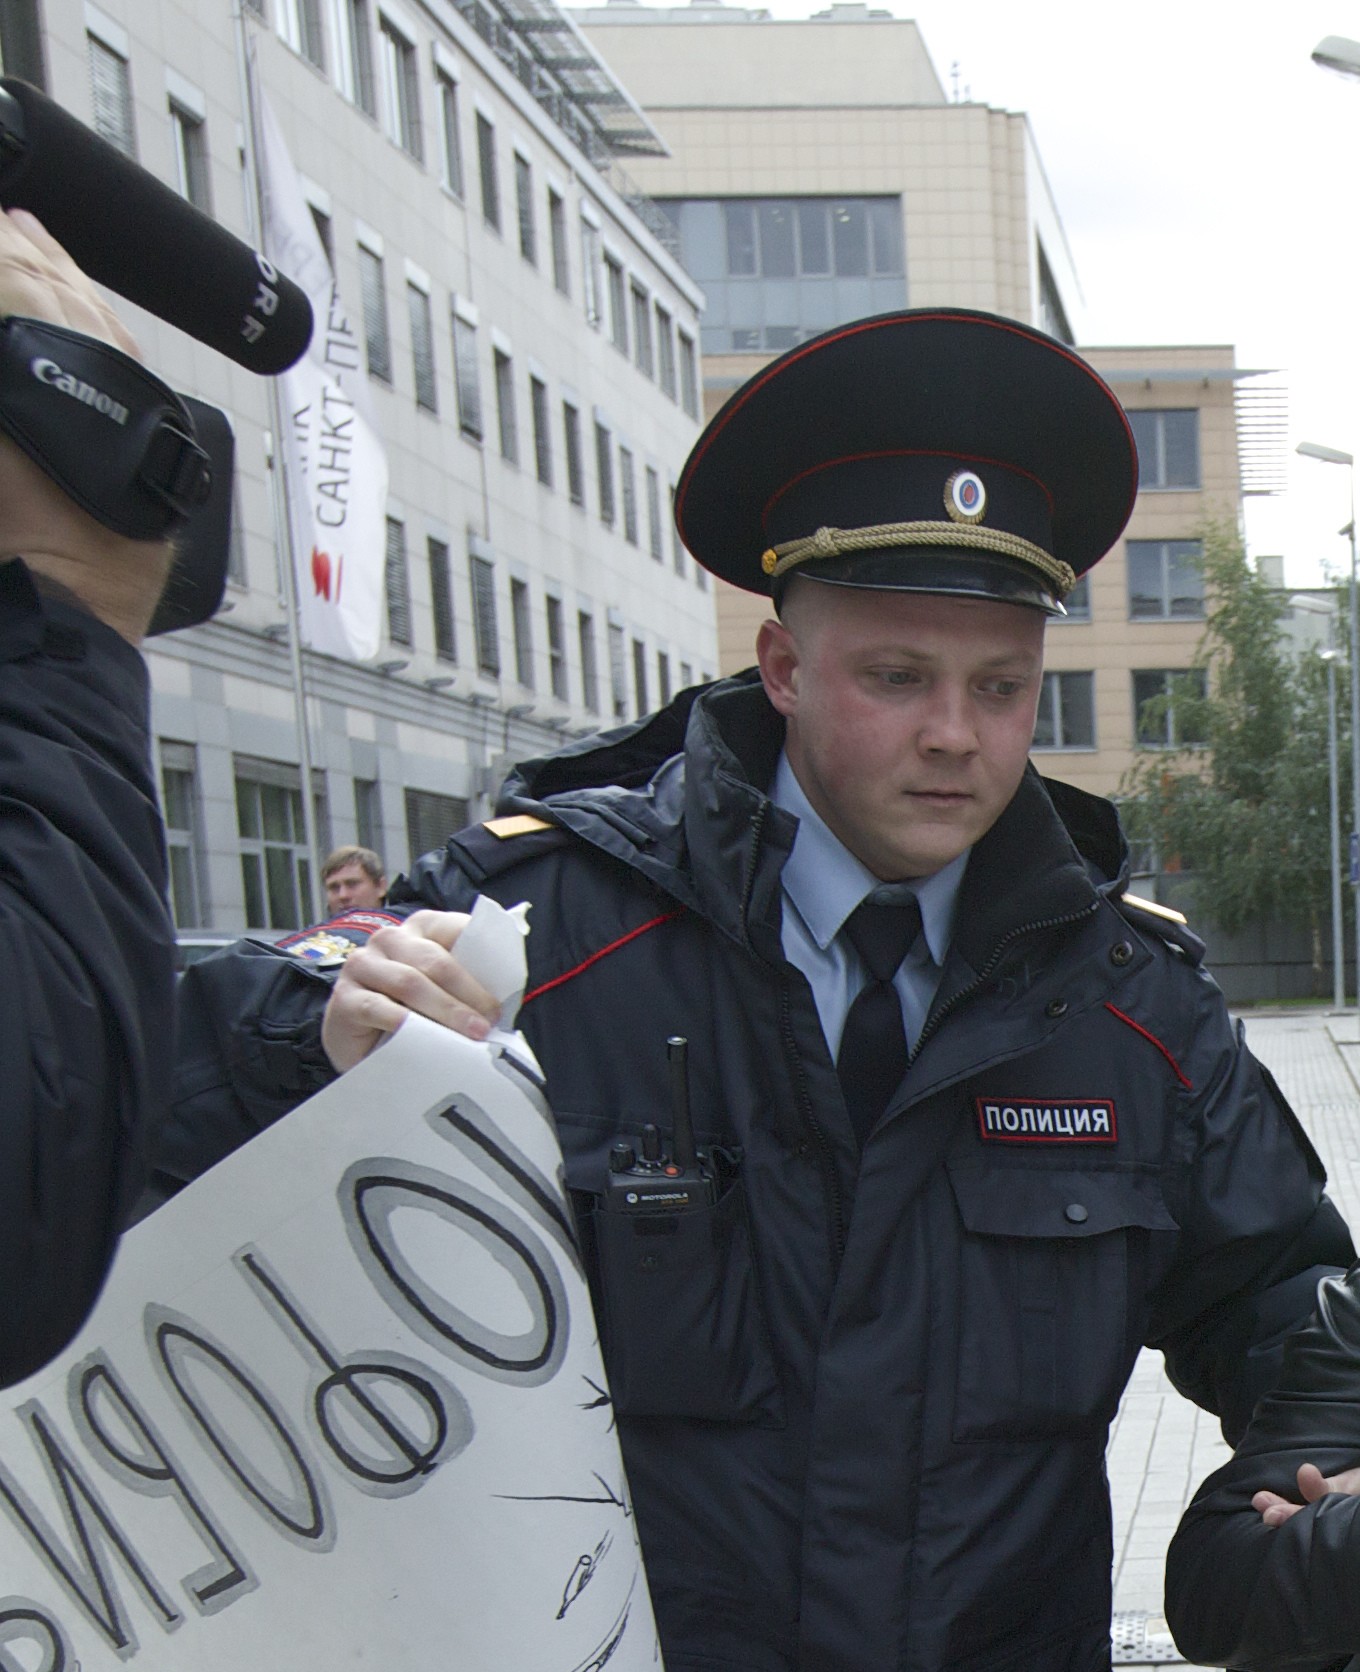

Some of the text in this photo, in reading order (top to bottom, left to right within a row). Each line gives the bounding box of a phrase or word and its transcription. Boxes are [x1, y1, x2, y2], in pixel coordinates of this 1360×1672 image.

[240, 252, 279, 345] ORF
[31, 357, 129, 425] Canon
[985, 1105, 1110, 1136] ПОЛИЦИЯ
